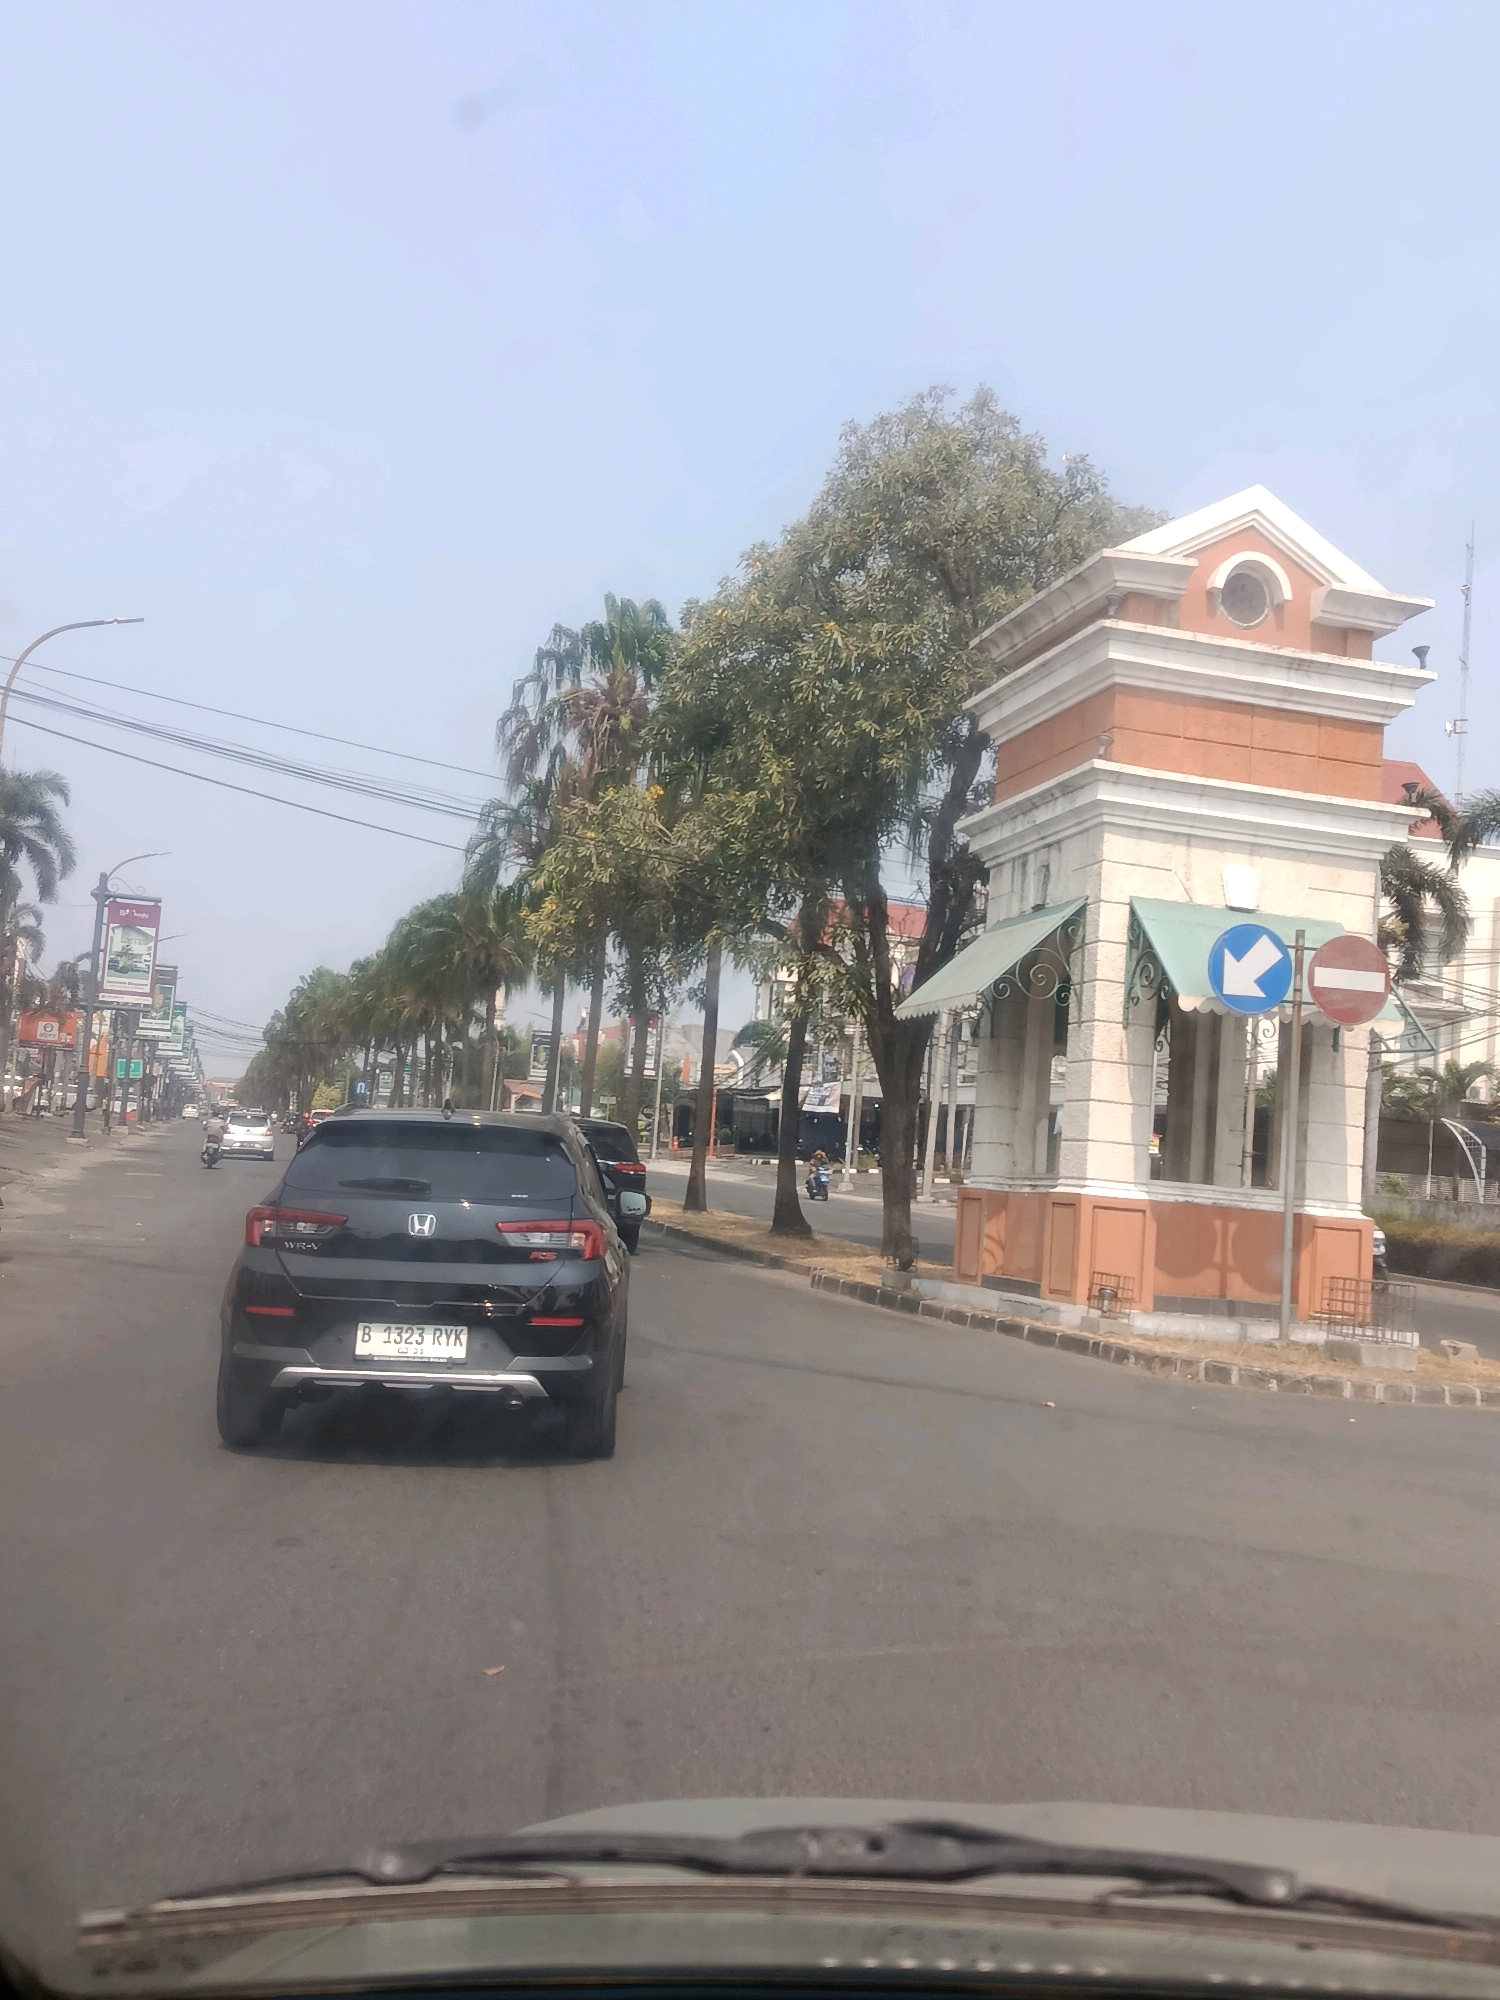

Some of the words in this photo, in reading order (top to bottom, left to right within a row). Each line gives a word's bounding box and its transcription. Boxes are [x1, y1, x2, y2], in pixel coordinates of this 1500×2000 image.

[284, 1241, 322, 1250] WR-V
[529, 1251, 557, 1260] RS
[361, 1325, 372, 1344] B
[383, 1326, 426, 1346] 1323
[432, 1327, 464, 1347] RYK
